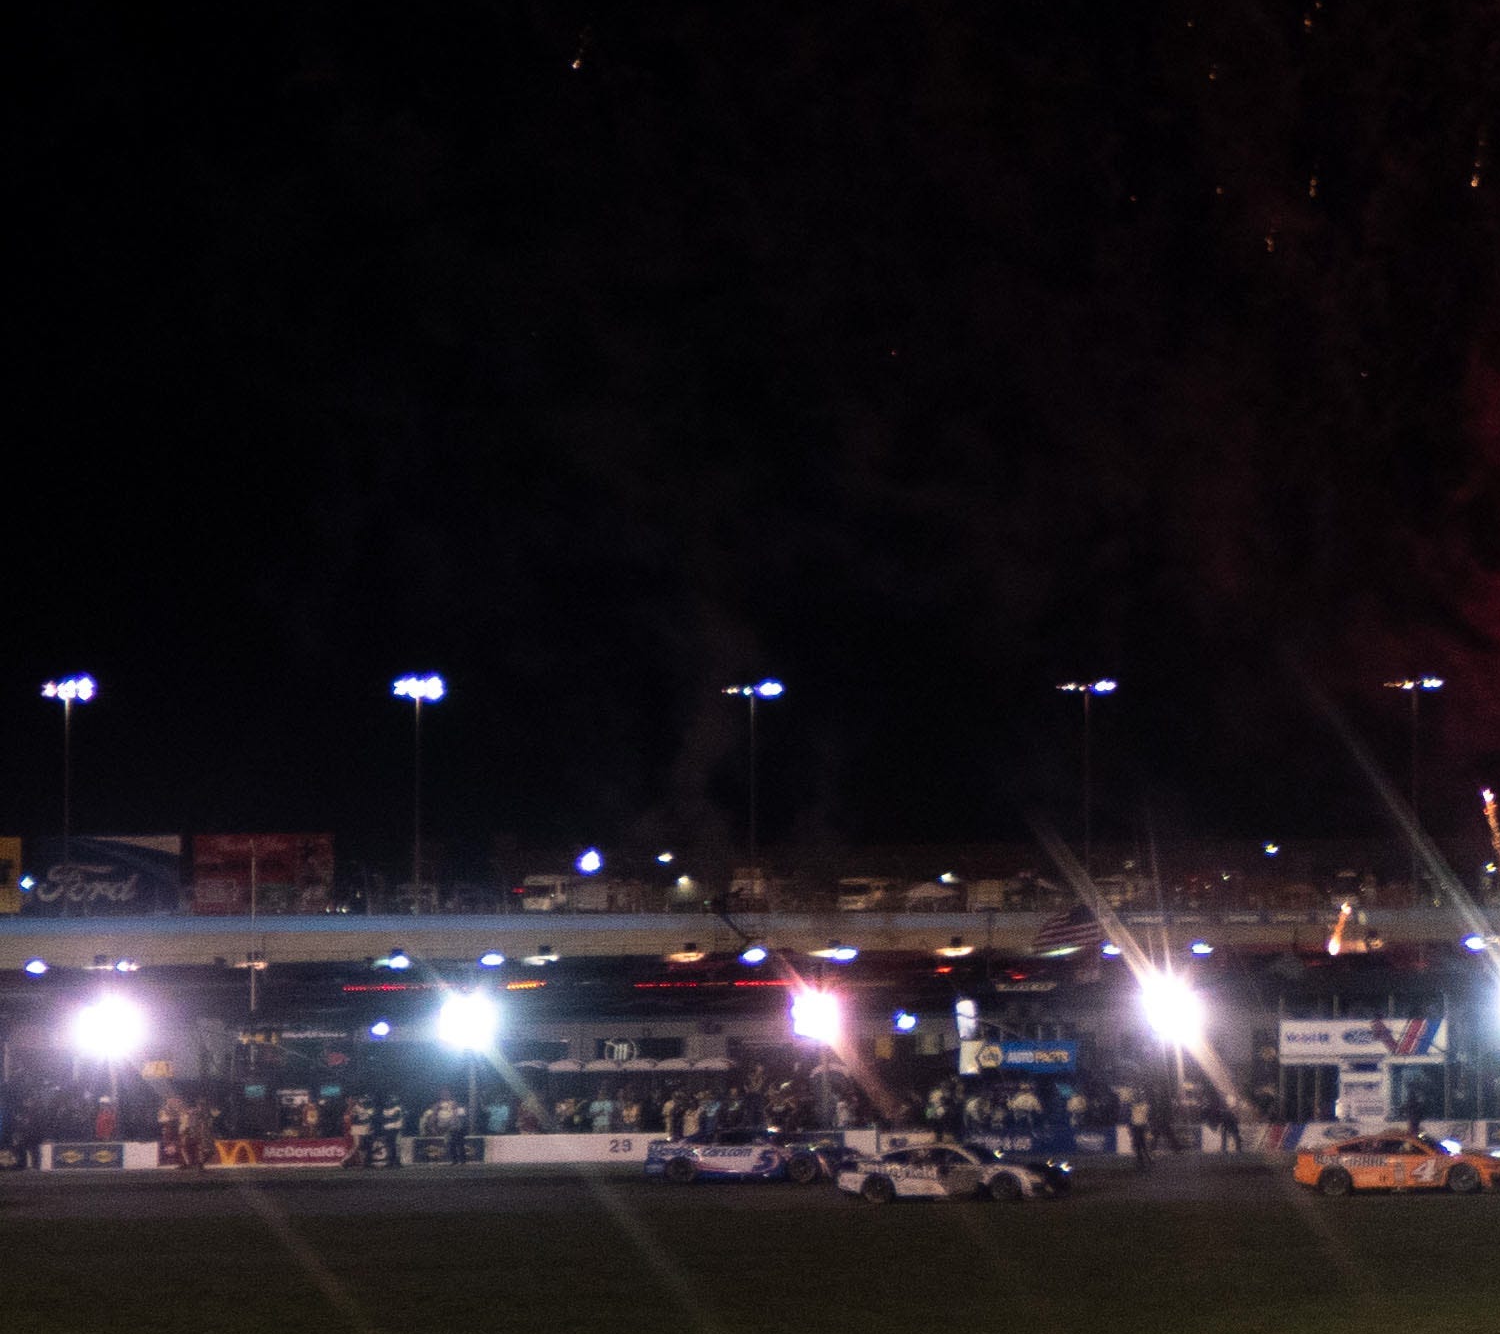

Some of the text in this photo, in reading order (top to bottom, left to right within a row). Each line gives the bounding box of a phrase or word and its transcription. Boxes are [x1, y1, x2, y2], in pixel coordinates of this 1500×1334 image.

[37, 863, 139, 903] Ford
[263, 1139, 346, 1159] McDonald's
[1412, 1159, 1437, 1183] 4
